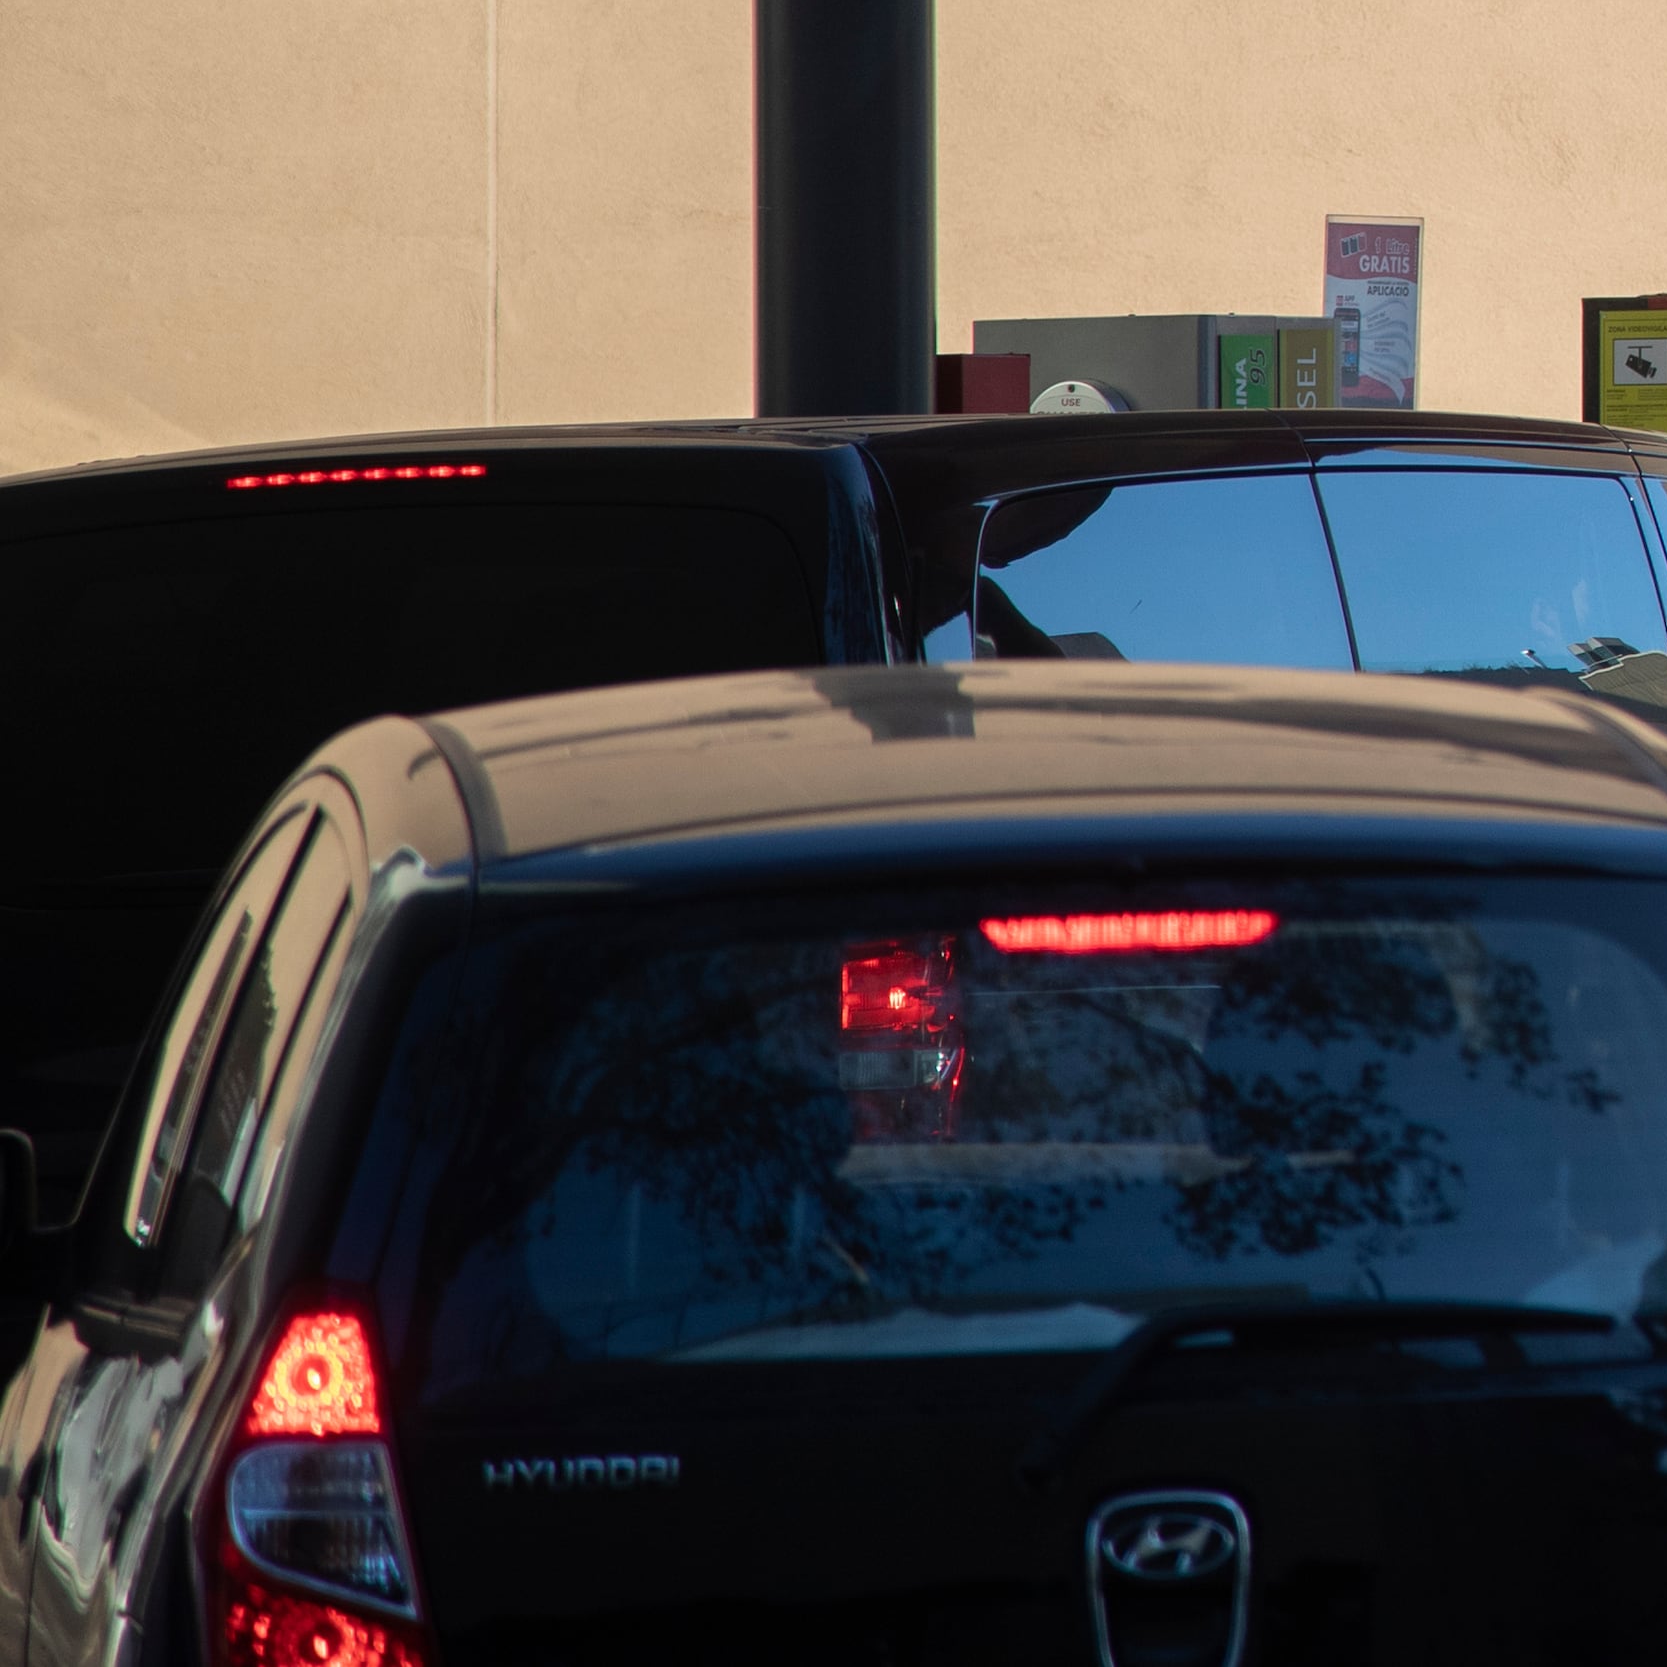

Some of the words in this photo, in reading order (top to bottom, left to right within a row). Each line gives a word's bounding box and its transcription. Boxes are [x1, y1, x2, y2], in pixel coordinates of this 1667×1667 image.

[1359, 255, 1410, 274] GRATIS
[1249, 348, 1266, 385] 95
[1061, 398, 1082, 407] USE
[483, 1455, 680, 1486] HYUNDAI
